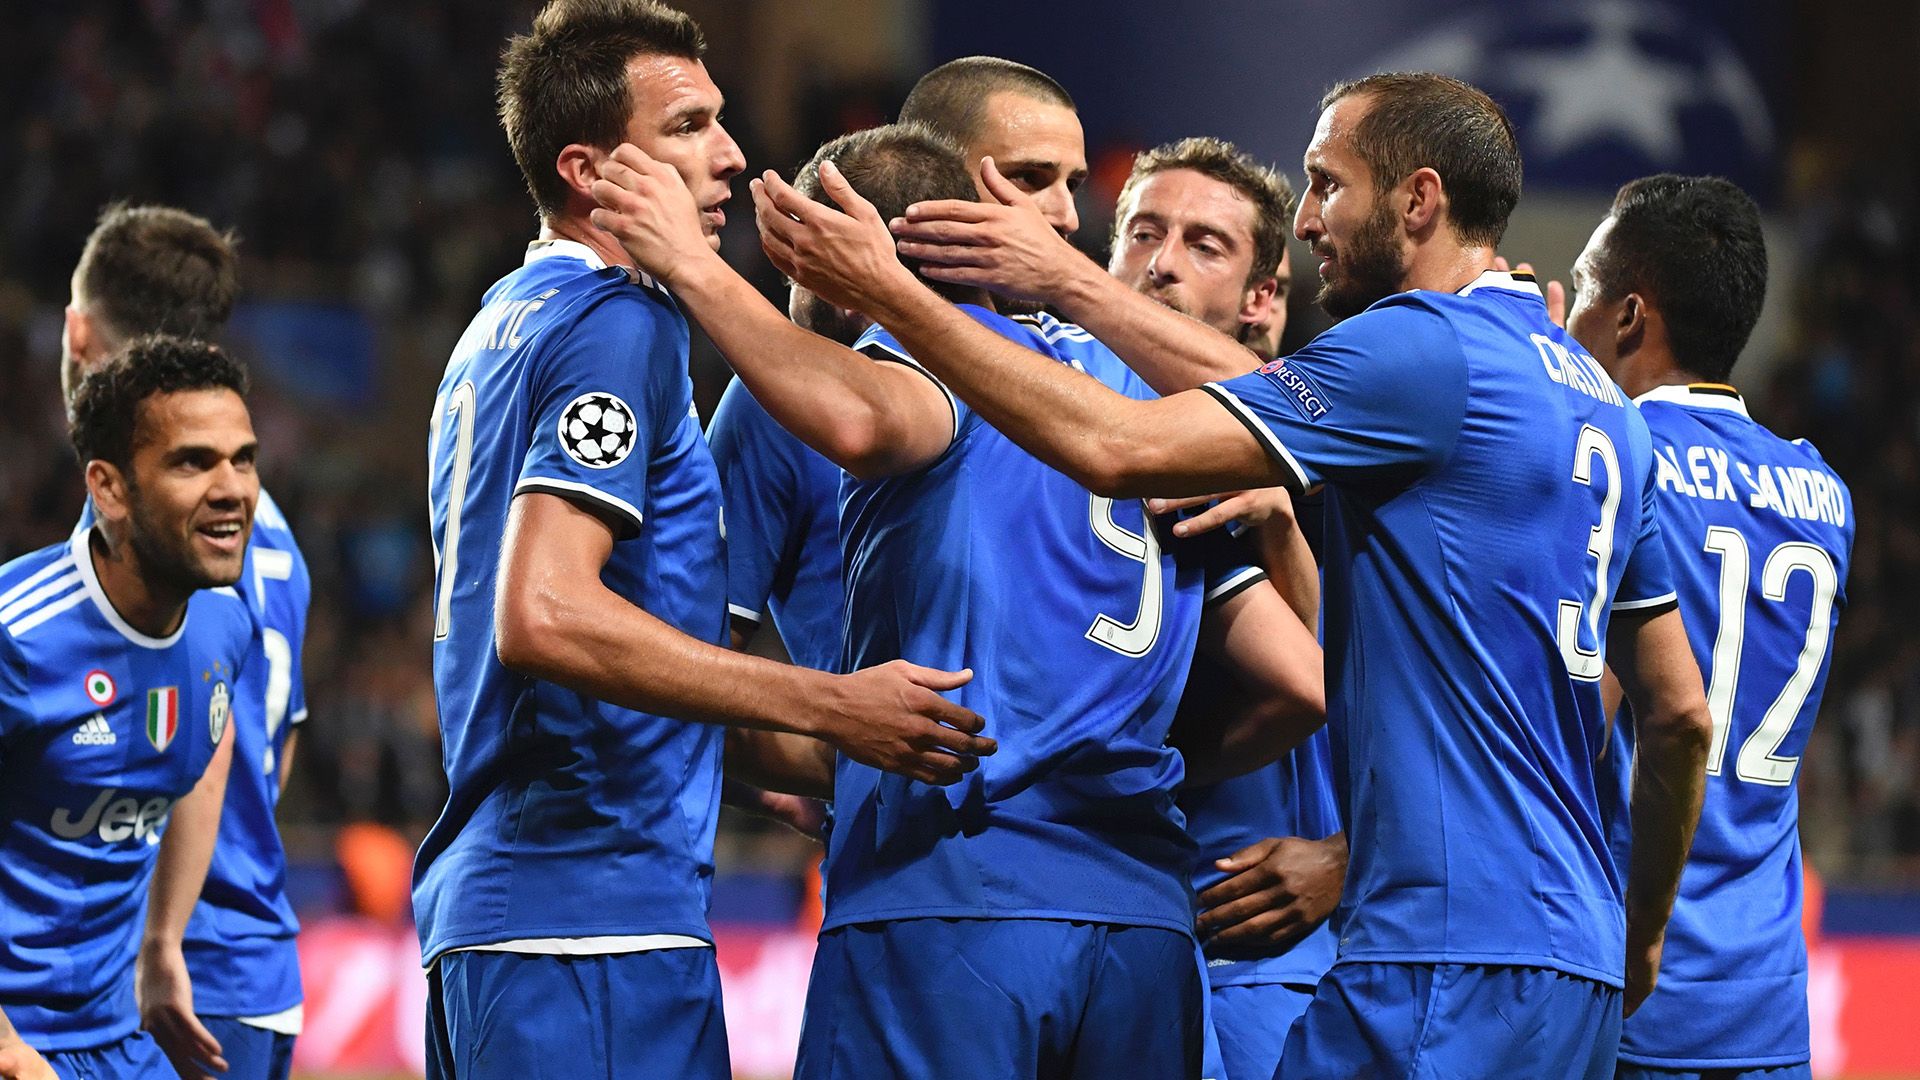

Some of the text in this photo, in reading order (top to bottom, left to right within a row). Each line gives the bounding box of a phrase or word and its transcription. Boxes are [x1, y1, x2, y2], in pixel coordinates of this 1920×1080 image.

[1273, 366, 1327, 417] RESPECT
[1653, 445, 1846, 528] ALEX SANDRO
[1085, 493, 1163, 659] 9
[1557, 423, 1621, 682] 3
[1703, 525, 1838, 786] 12
[72, 732, 116, 745] adidas
